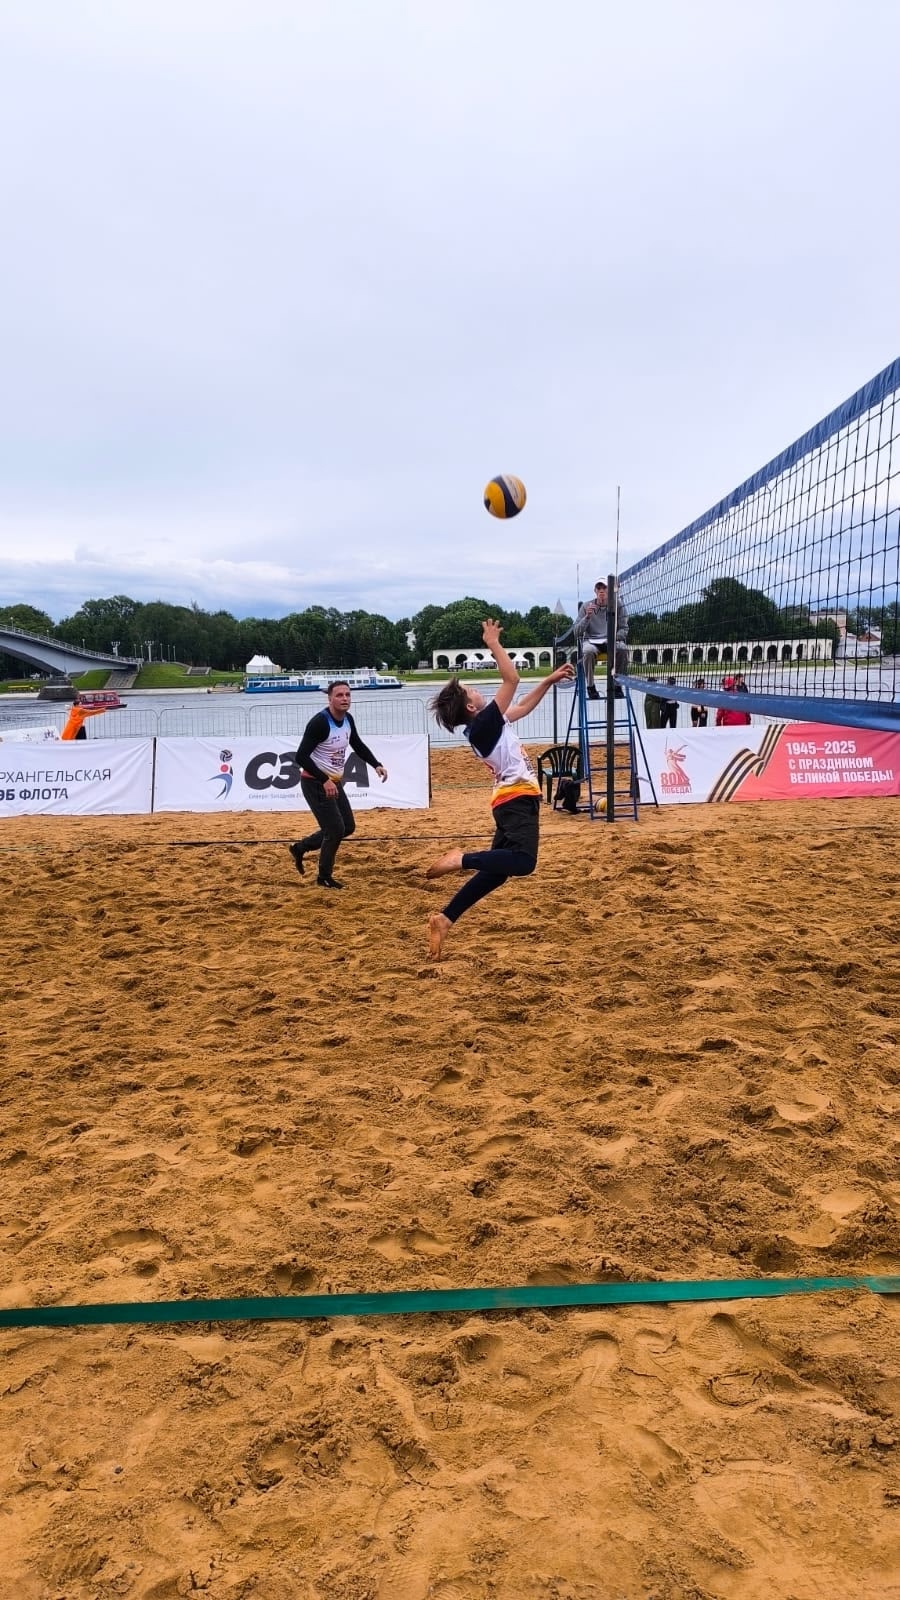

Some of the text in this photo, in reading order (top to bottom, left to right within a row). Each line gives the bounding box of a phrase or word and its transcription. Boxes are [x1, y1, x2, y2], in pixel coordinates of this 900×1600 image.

[244, 751, 370, 791] СЗА
[788, 757, 874, 771] С ПРАЗДНИКОМ
[660, 772, 677, 786] 80
[790, 769, 895, 784] ВЕЛИКОЙ ПОБЕДЫ!
[19, 787, 69, 801] ФЛОТА
